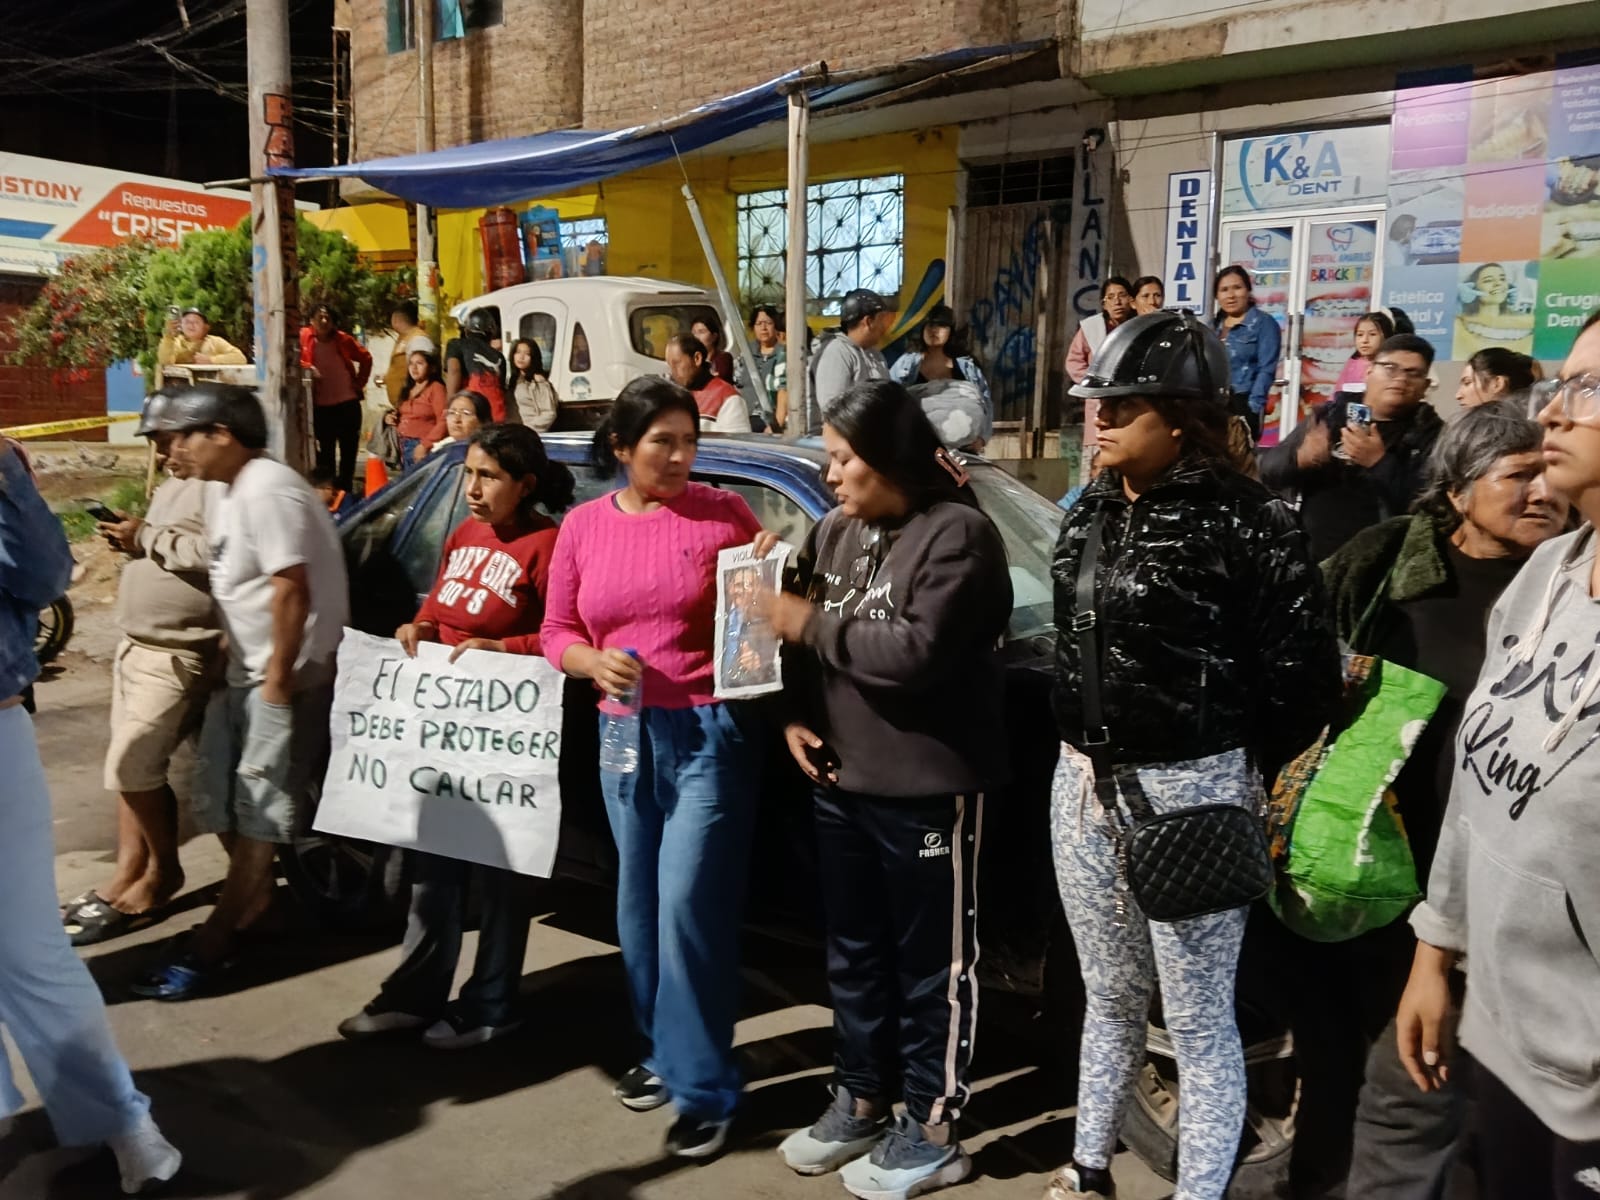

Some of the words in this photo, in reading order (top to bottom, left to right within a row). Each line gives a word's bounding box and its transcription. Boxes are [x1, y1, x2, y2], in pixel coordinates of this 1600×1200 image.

[121, 190, 208, 218] Repuestos
[1287, 179, 1342, 196] DENT
[1173, 178, 1201, 302] DENTAL
[1433, 310, 1444, 325] y
[412, 672, 541, 714] ESTADO
[347, 710, 406, 742] DEBE
[419, 718, 560, 760] PROTEGER
[347, 752, 388, 790] NO
[408, 765, 538, 810] CALLAR
[1457, 701, 1542, 822] King
